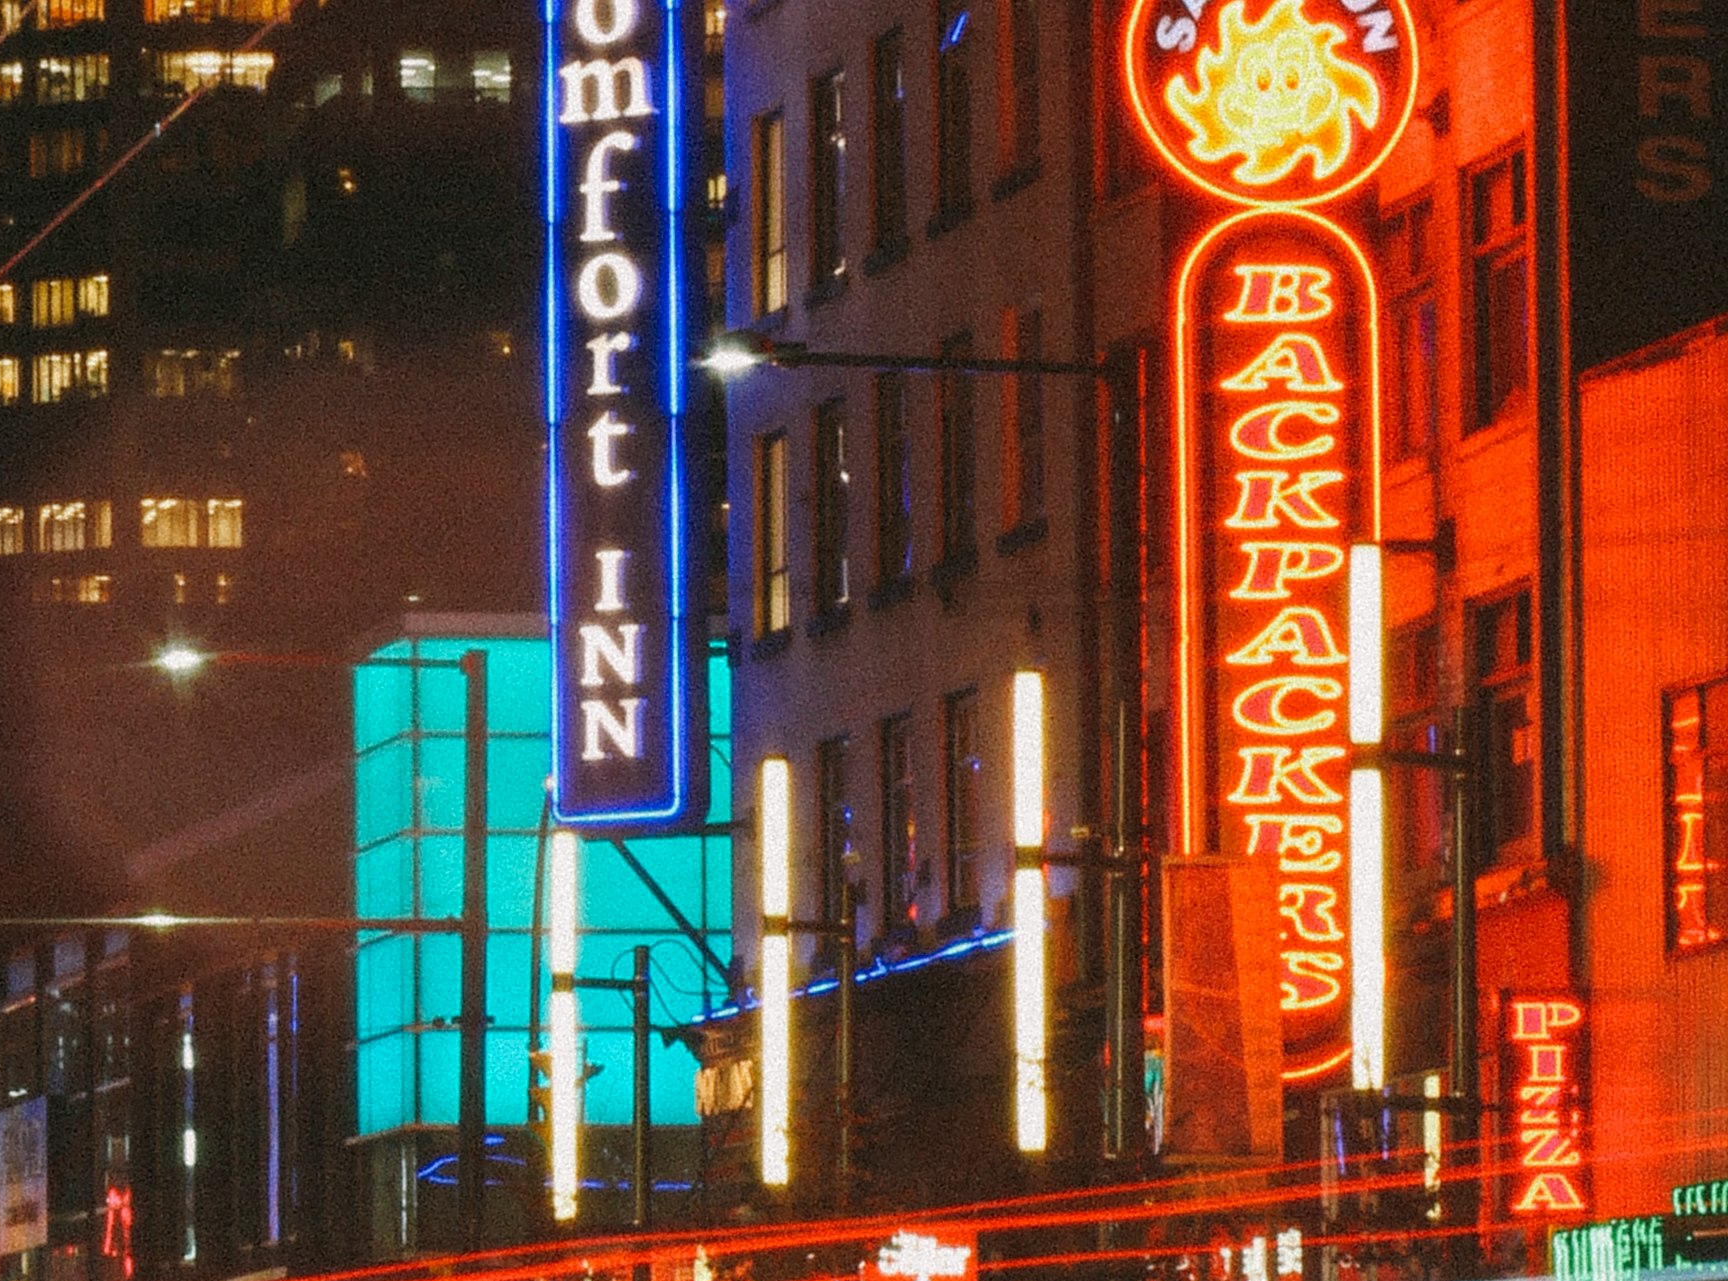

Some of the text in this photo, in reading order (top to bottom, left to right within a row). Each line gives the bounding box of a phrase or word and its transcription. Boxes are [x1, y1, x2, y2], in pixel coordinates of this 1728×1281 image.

[579, 549, 646, 762] INN
[1221, 264, 1348, 1012] BACKPACKERS
[1513, 1001, 1584, 1211] PIZZA
